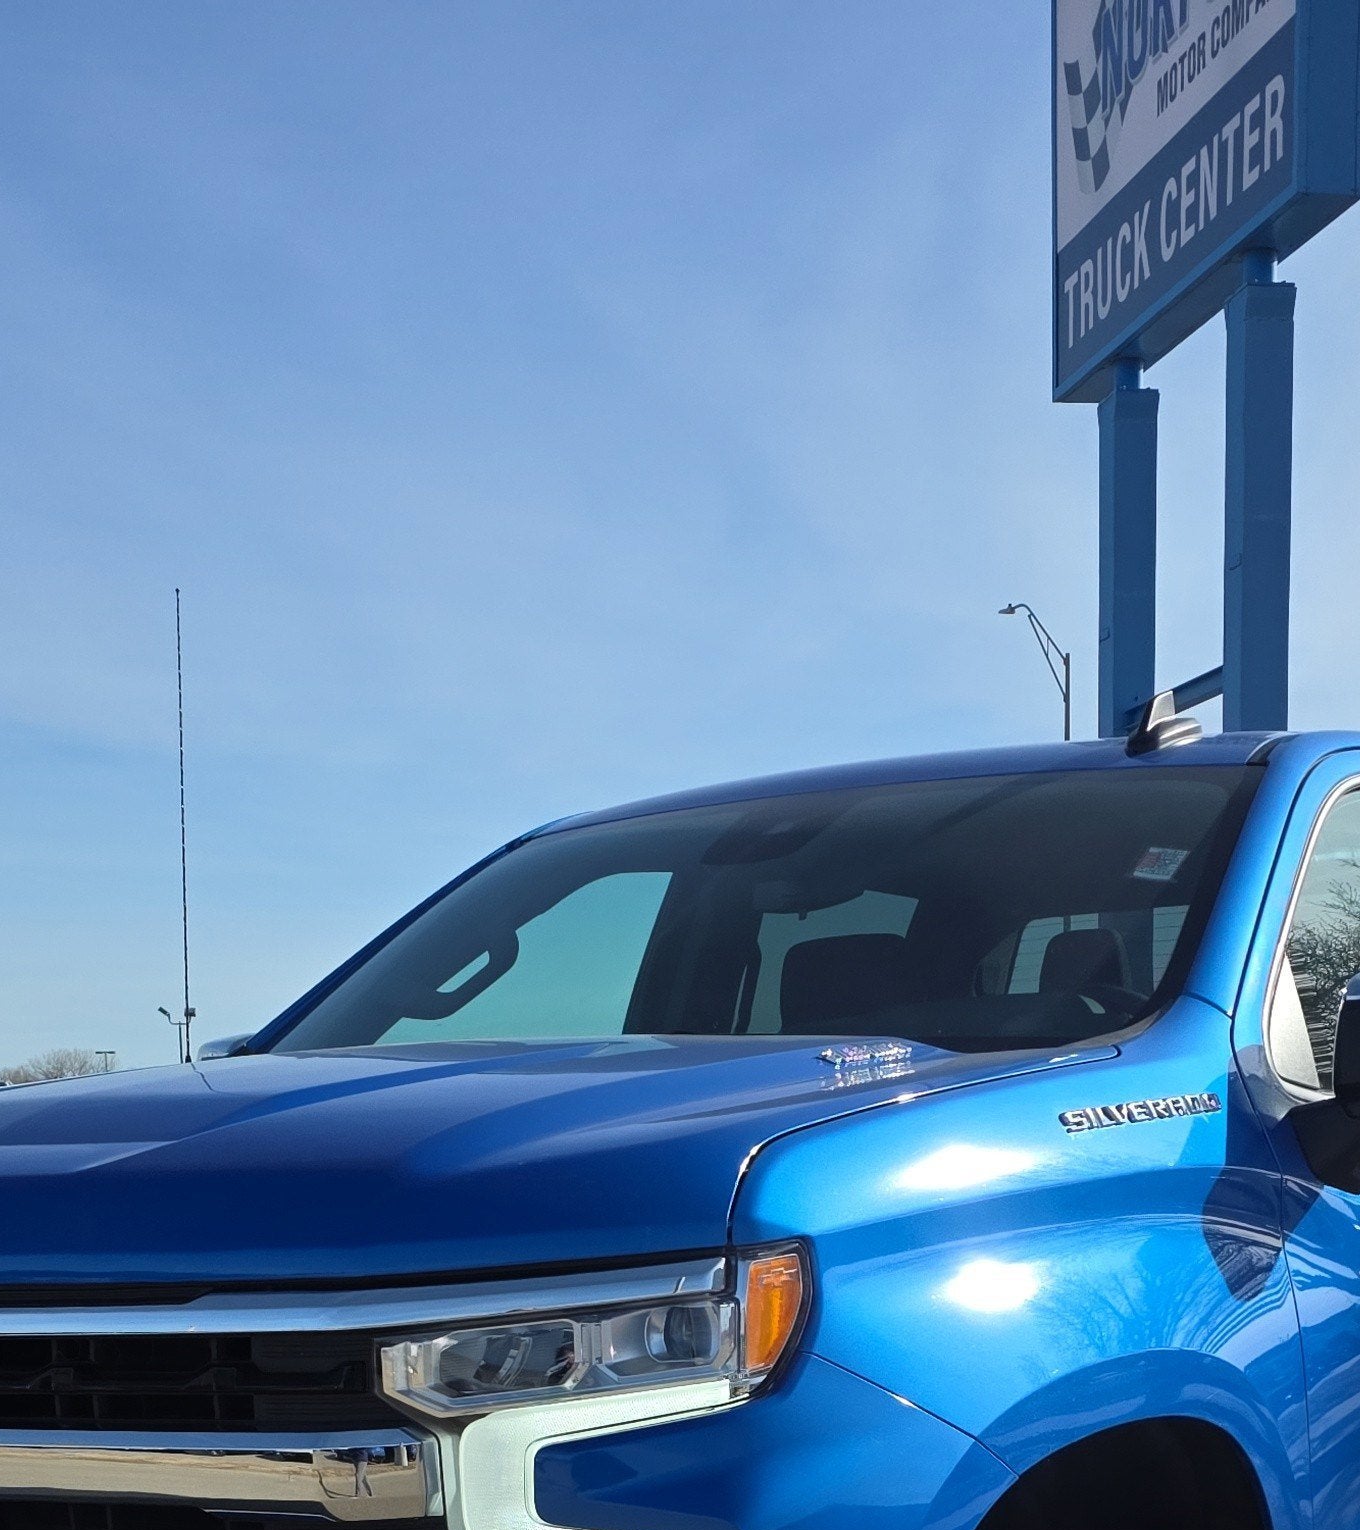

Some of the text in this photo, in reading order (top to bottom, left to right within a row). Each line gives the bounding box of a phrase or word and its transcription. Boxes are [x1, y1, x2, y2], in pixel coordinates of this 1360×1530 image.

[1156, 31, 1207, 118] MOTOR
[1063, 74, 1286, 349] TRUCK CENTER
[1058, 1092, 1223, 1134] SILVERADO
